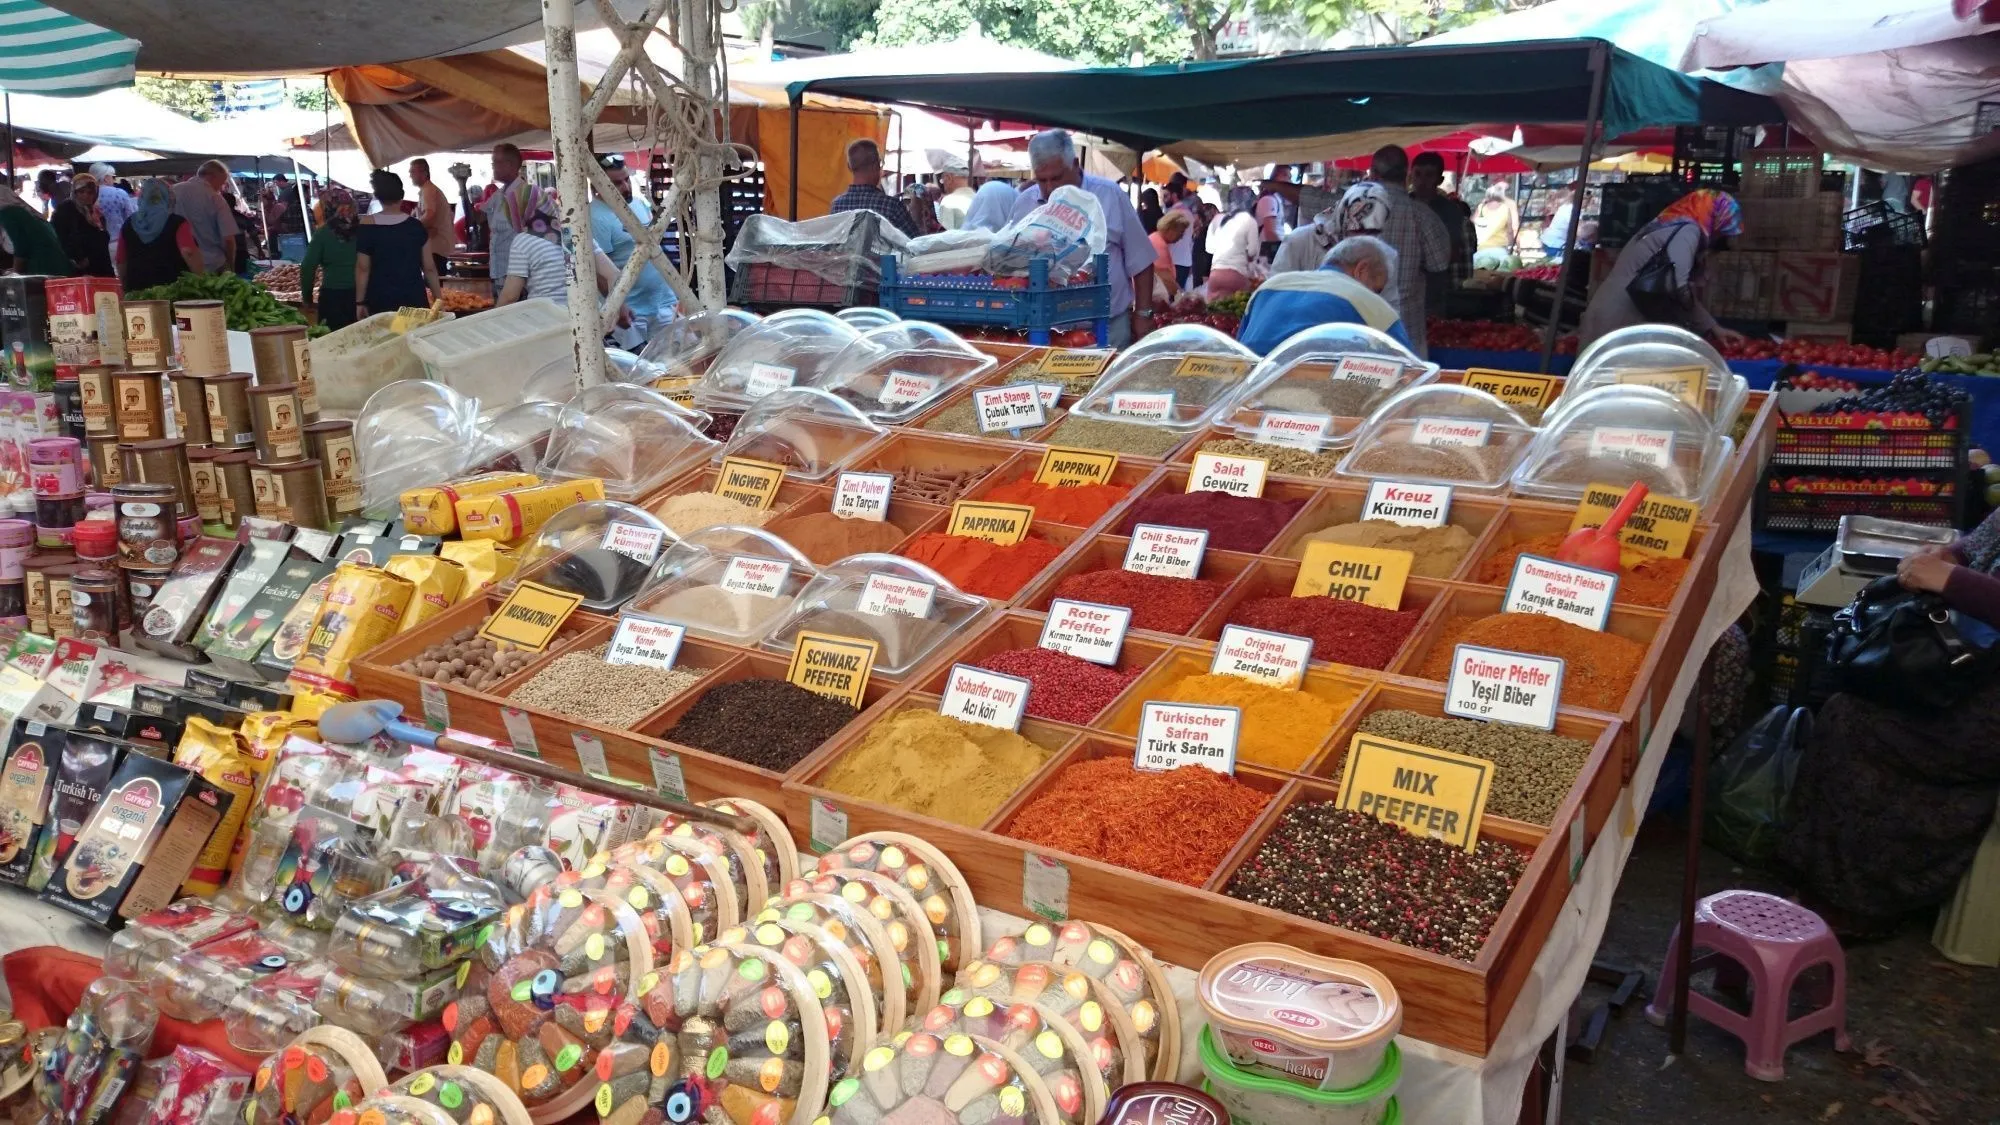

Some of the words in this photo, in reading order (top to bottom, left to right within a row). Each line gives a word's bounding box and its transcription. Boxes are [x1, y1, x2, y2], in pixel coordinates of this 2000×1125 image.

[57, 320, 78, 329] organik
[984, 394, 1003, 406] Zimt
[1003, 391, 1031, 403] Stange
[1502, 385, 1541, 398] GANG
[985, 405, 1010, 422] Çubuk
[1011, 403, 1036, 416] Tarçın
[1118, 399, 1167, 410] Rosmarin
[62, 413, 84, 423] Turkish
[1266, 417, 1320, 432] Kardamom
[1420, 424, 1482, 437] Koriander
[1635, 433, 1667, 448] Körner
[1050, 459, 1100, 477] PAPPRIKA
[1212, 461, 1246, 477] Salat
[842, 479, 859, 494] Zimt
[860, 480, 886, 496] Pulver
[1202, 475, 1249, 493] Gewürz
[840, 494, 854, 507] Toz
[855, 495, 880, 511] Tarçın
[1385, 487, 1433, 503] Kreuz
[1372, 502, 1439, 520] Kümmel
[1649, 503, 1692, 523] FLEISCH
[615, 525, 657, 540] Schwarz
[961, 516, 1016, 533] PAPPRIKA
[613, 536, 652, 551] kümmel
[1140, 531, 1162, 544] Chili
[1164, 533, 1199, 546] Scharf
[1151, 543, 1178, 555] Extra
[735, 560, 760, 571] Weisser
[761, 563, 783, 573] Pfeffer
[1131, 563, 1144, 571] 100
[1133, 551, 1148, 562] Acı
[1150, 553, 1164, 564] Pul
[1165, 555, 1191, 567] Biber
[744, 570, 765, 581] Pulver
[1328, 560, 1382, 581] CHILI
[1525, 563, 1573, 583] Osmanisch
[1573, 575, 1605, 592] Fleisch
[261, 585, 288, 597] Turkish
[288, 590, 301, 600] Tea
[727, 578, 745, 590] Beyaz
[757, 583, 775, 592] biber
[872, 580, 906, 594] Schwarzer
[905, 586, 929, 599] Pfeffer
[1328, 582, 1370, 603] HOT
[1545, 583, 1577, 599] Gewürz
[870, 601, 881, 612] Toz
[885, 594, 906, 606] Pulver
[1515, 603, 1533, 613] 100
[1520, 589, 1555, 608] Karışık
[1556, 598, 1594, 617] Baharat
[504, 604, 557, 628] MUSKATNUS
[1068, 607, 1111, 622] Roter
[627, 622, 652, 636] Weisser
[652, 625, 674, 638] Pfeffer
[1059, 619, 1111, 636] Pfeffer
[312, 625, 337, 648] Rize
[634, 635, 657, 647] Körner
[1048, 630, 1073, 642] Kırmızı
[1075, 634, 1093, 645] Tane
[1093, 636, 1114, 648] biber
[615, 643, 634, 655] Beyaz
[634, 645, 650, 657] Tane
[650, 648, 668, 661] Biber
[1047, 641, 1061, 650] 100
[1244, 637, 1286, 653] Original
[19, 651, 45, 668] apple
[612, 657, 624, 665] 100
[805, 649, 861, 672] SCHWARZ
[1224, 646, 1261, 662] indisch
[1263, 653, 1298, 668] Safran
[62, 659, 89, 675] apple
[1234, 660, 1280, 678] Zerdeçal
[1463, 657, 1506, 681] Grüner
[1508, 664, 1550, 687] Pfeffer
[803, 668, 852, 690] PFEFFER
[955, 675, 991, 699] Scharfer
[991, 688, 1018, 709] curry
[1471, 680, 1501, 705] Yeşil
[1503, 686, 1536, 707] Biber
[962, 698, 977, 716] Acı
[1457, 700, 1477, 710] 100
[1480, 704, 1493, 714] gr
[1155, 711, 1226, 728] Türkischer
[1165, 727, 1209, 741] Safran
[1148, 739, 1176, 753] Türk
[1180, 742, 1224, 758] Safran
[1145, 755, 1163, 764] 100
[1165, 757, 1177, 767] gr
[9, 773, 36, 786] organik
[1392, 767, 1439, 797] MIX
[57, 780, 86, 799] Turkish
[87, 788, 101, 802] Tea
[112, 805, 148, 824] organik
[1358, 790, 1459, 834] PFEFFER
[1228, 969, 1307, 1000] helva
[1285, 1059, 1325, 1080] helva
